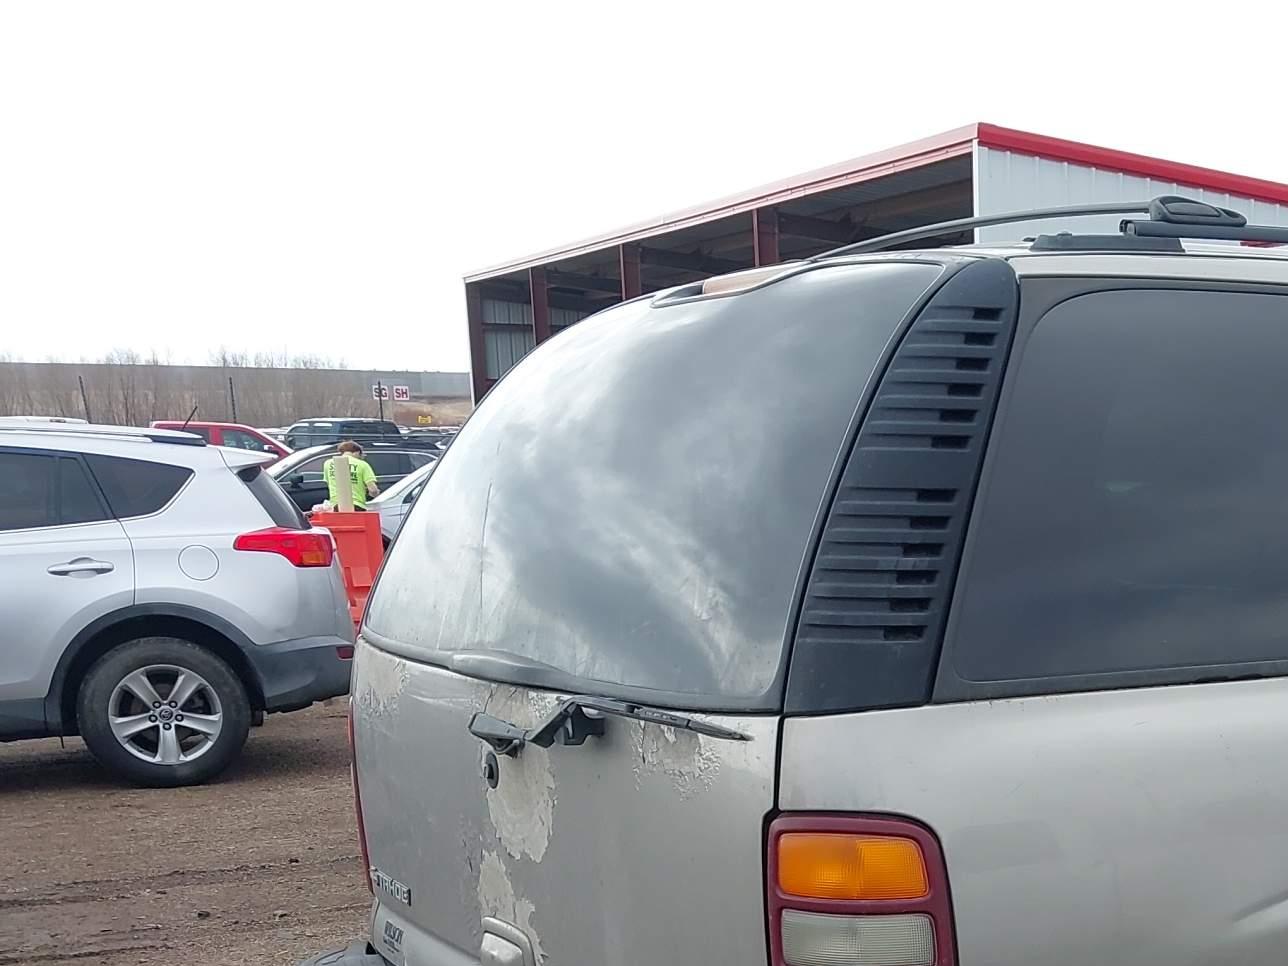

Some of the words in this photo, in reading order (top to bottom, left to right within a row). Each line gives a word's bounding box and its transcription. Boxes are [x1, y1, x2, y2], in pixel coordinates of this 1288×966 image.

[373, 387, 388, 398] SG
[394, 387, 409, 399] SH
[375, 870, 412, 907] TAHOE
